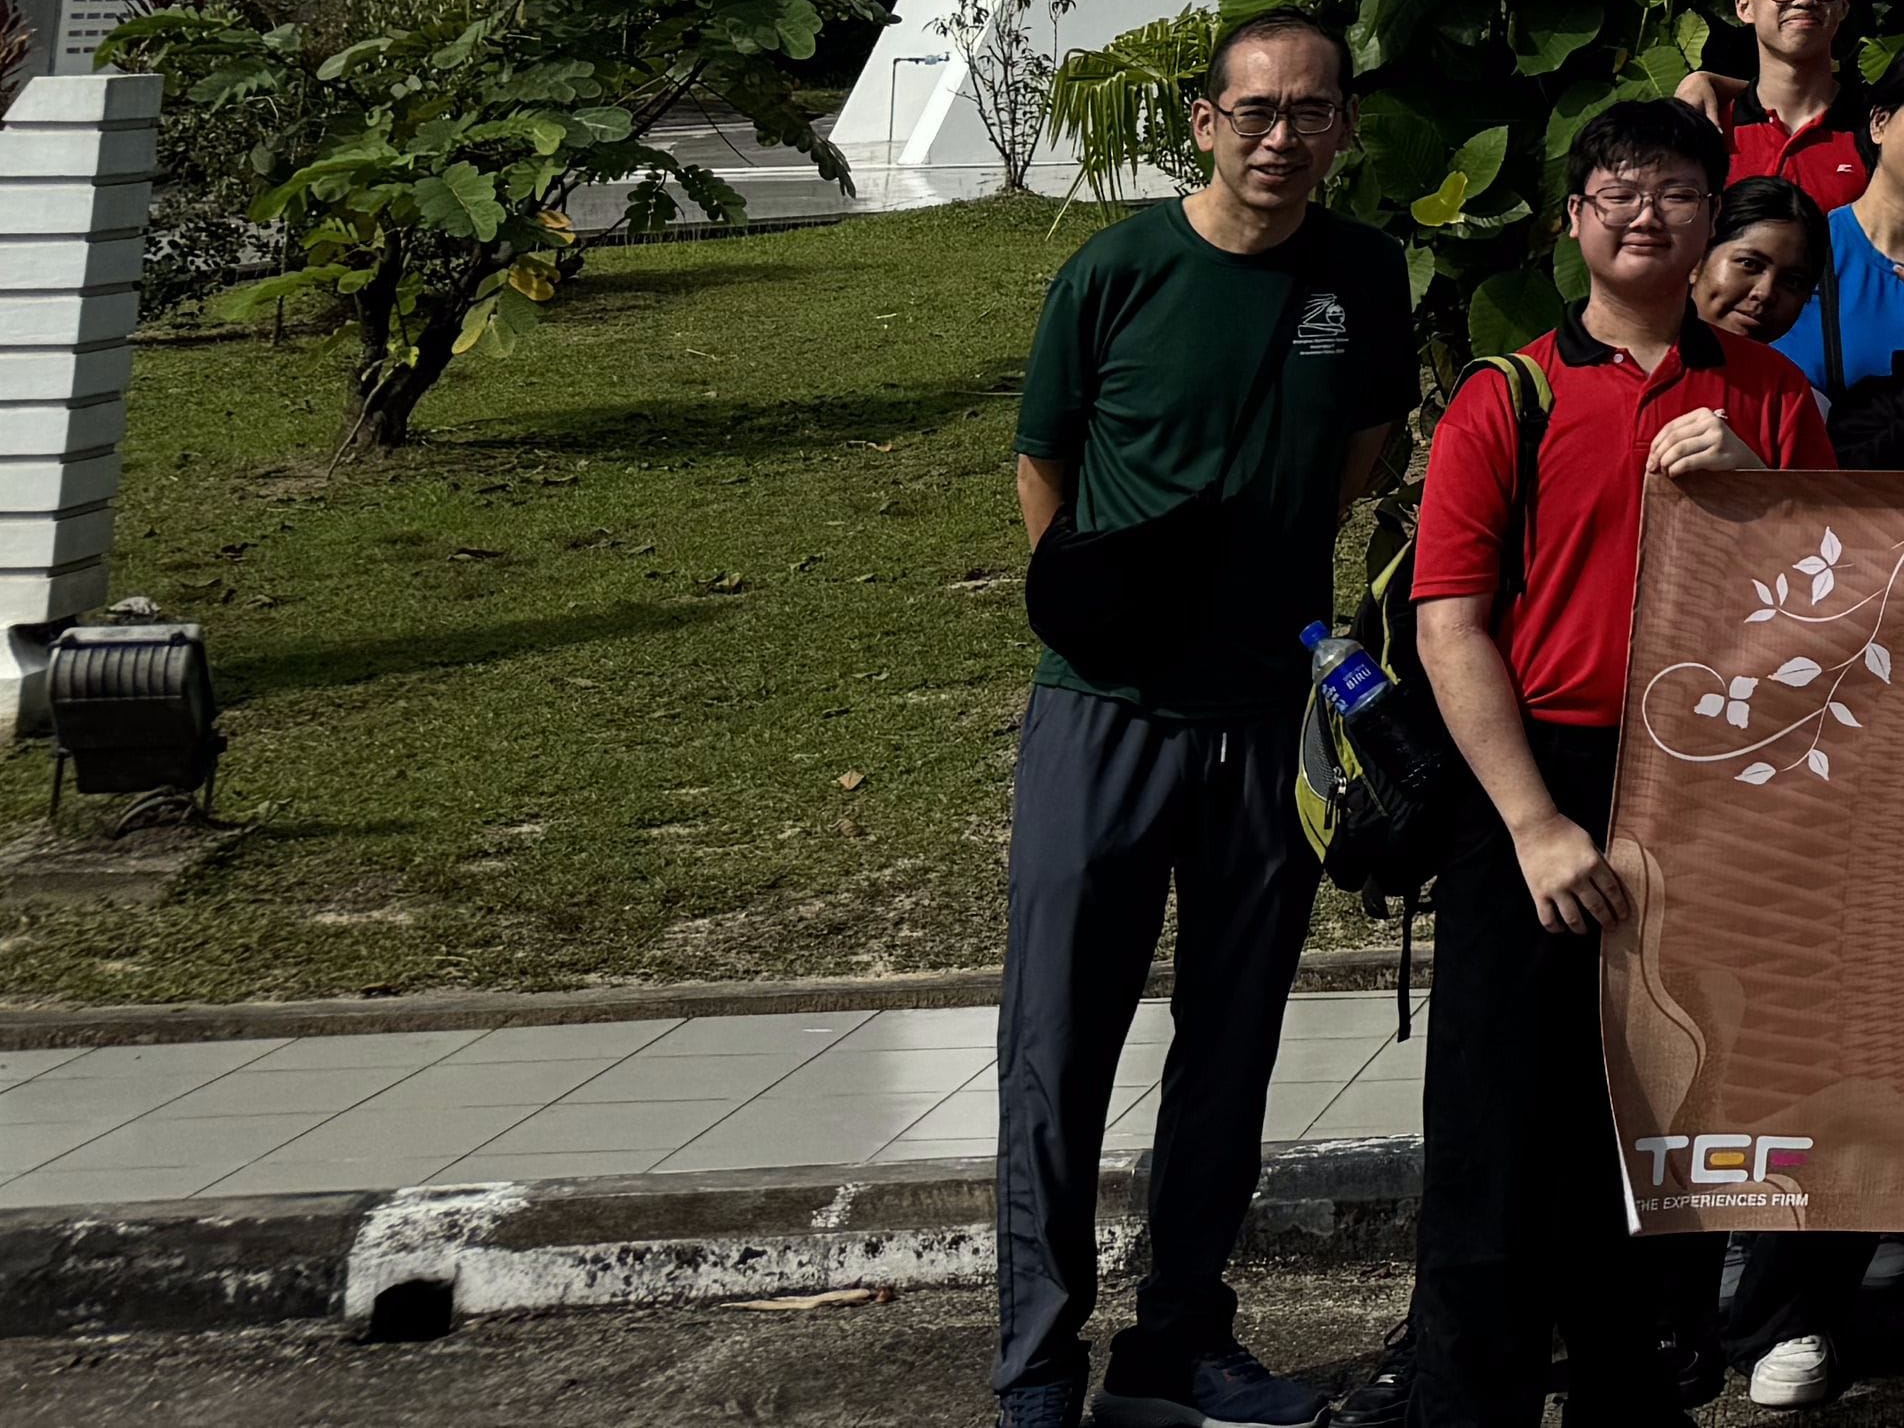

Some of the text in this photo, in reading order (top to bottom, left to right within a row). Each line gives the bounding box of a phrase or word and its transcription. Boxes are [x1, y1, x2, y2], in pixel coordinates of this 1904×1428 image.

[1636, 1193, 1809, 1211] THE EXPERIENCES FIRM
